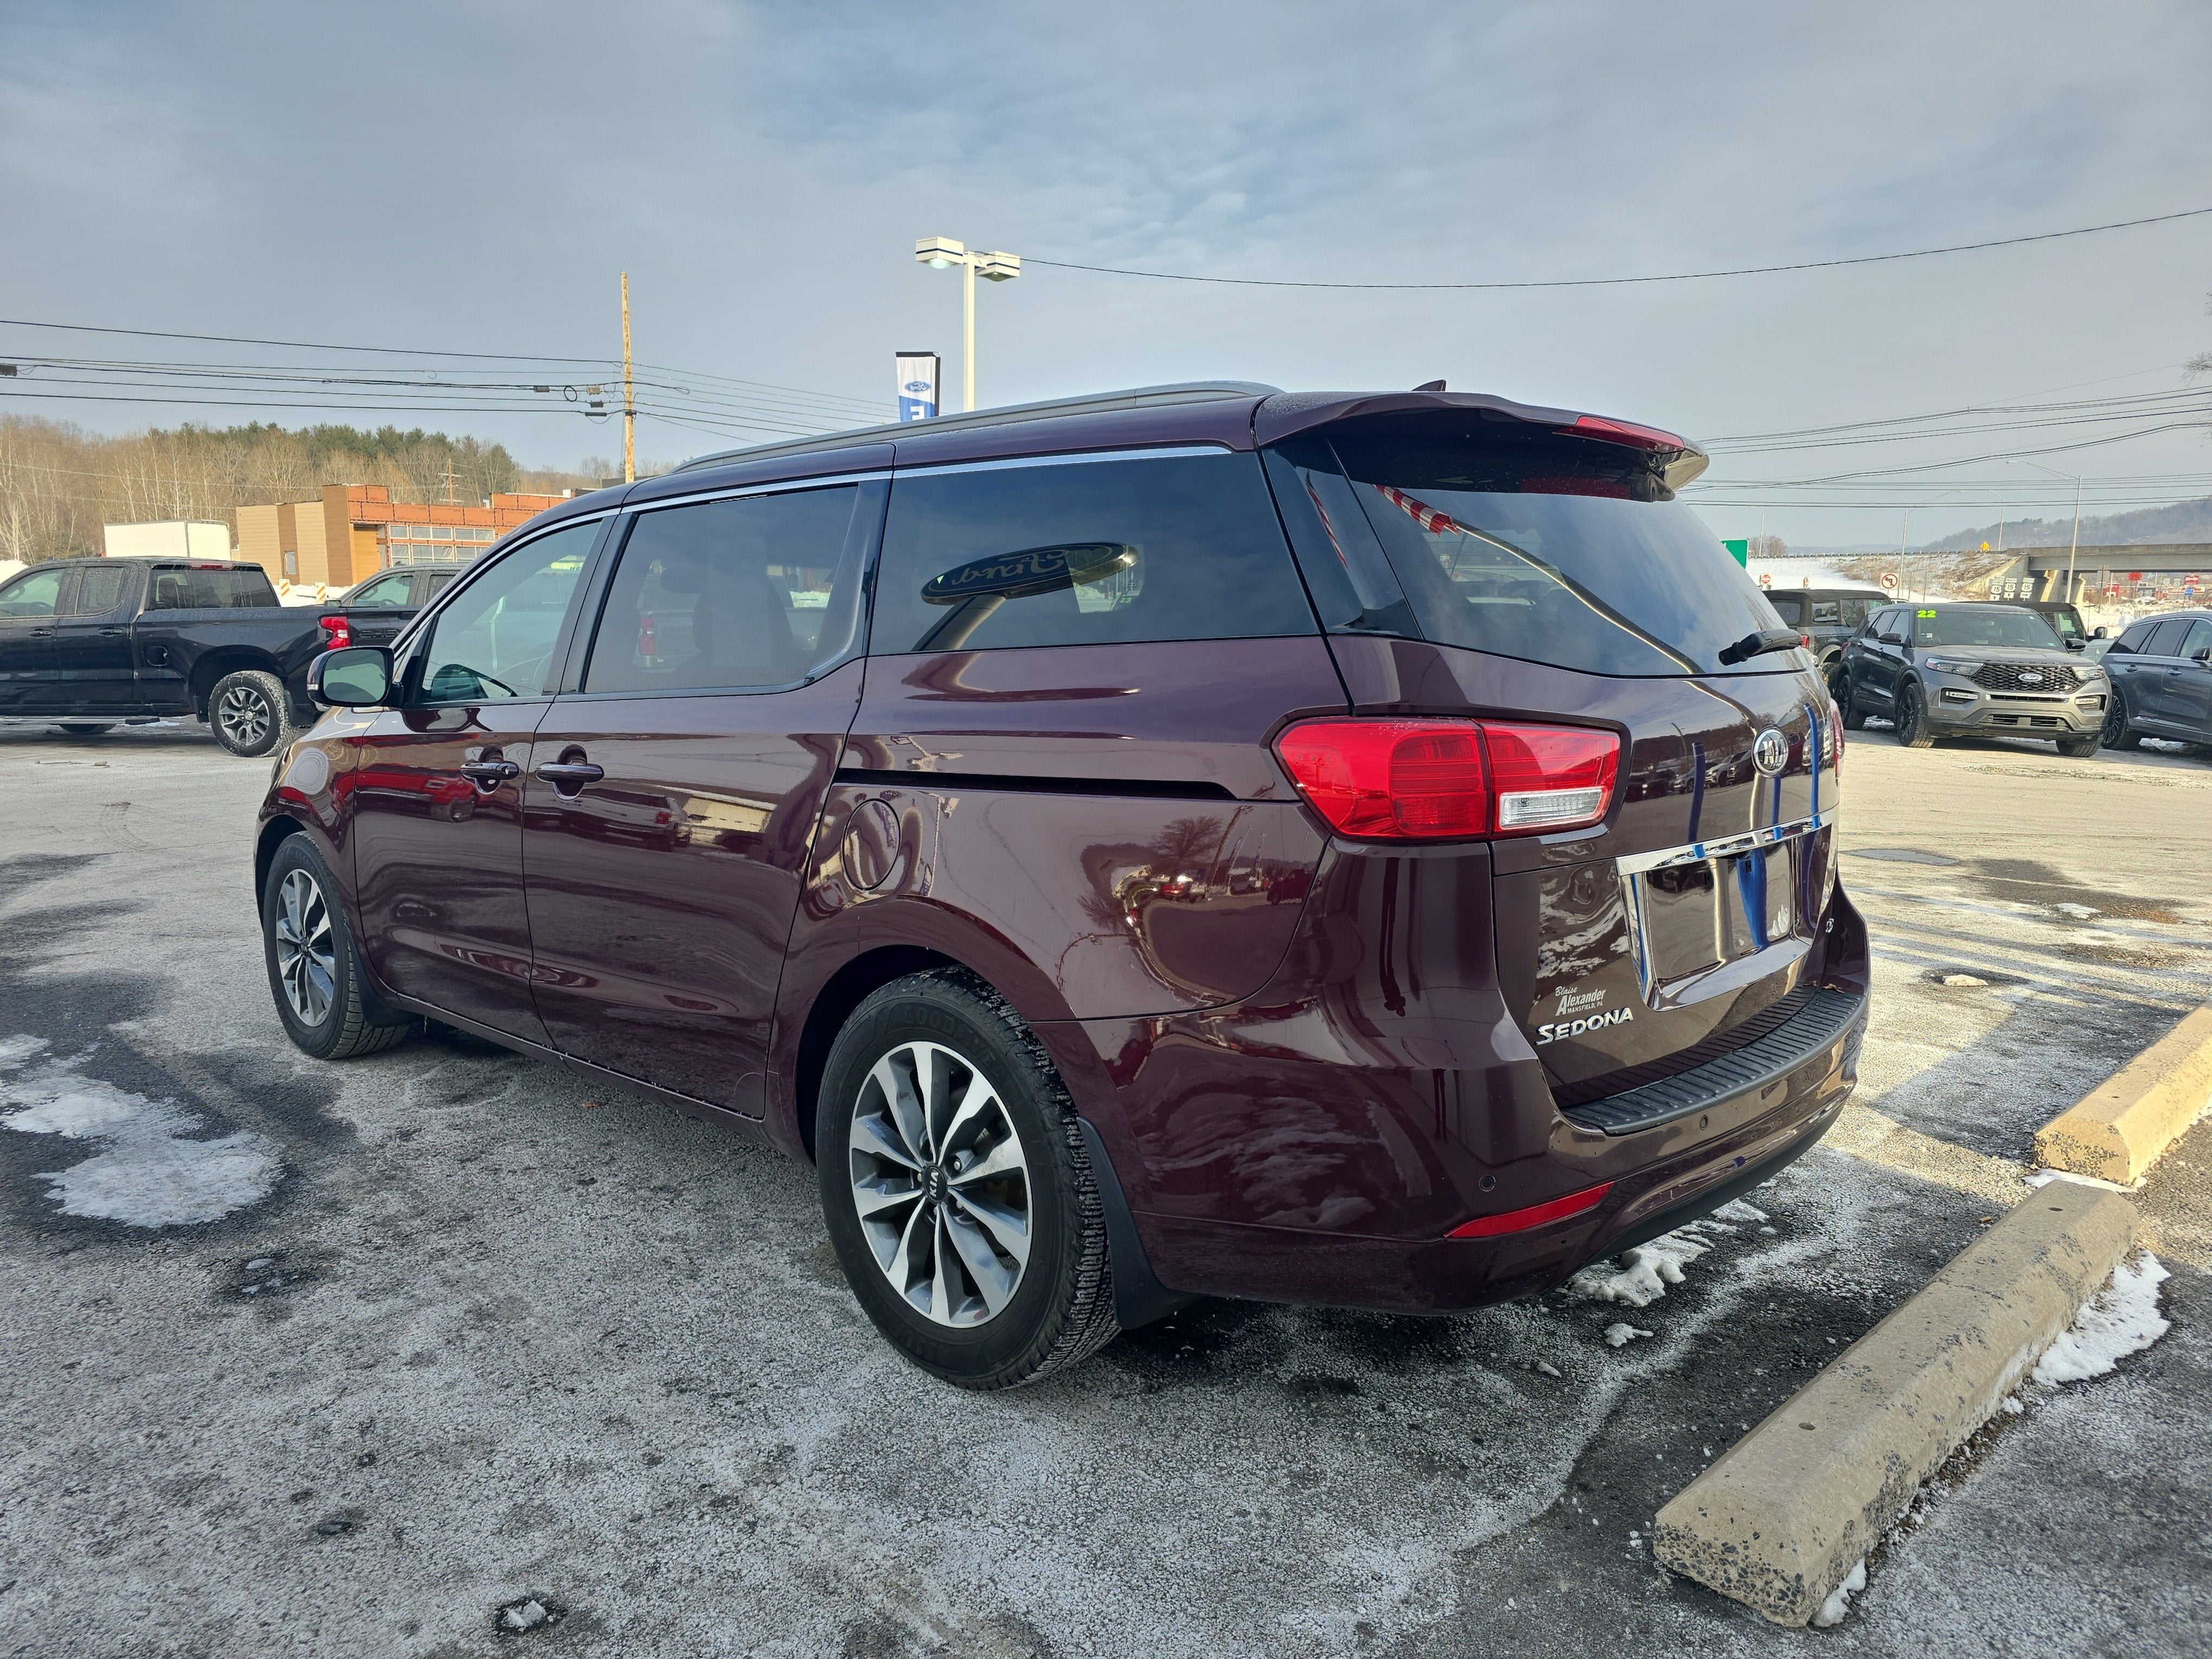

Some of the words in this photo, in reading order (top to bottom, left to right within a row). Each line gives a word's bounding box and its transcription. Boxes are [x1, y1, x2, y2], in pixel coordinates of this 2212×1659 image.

[1917, 610, 1936, 618] 22
[1762, 738, 1786, 765] KIA
[1555, 986, 1578, 996] Blaise
[1555, 988, 1606, 1017] Alexander
[1567, 1002, 1596, 1014] MANSFIELD,
[1535, 1007, 1634, 1046] SEDONA
